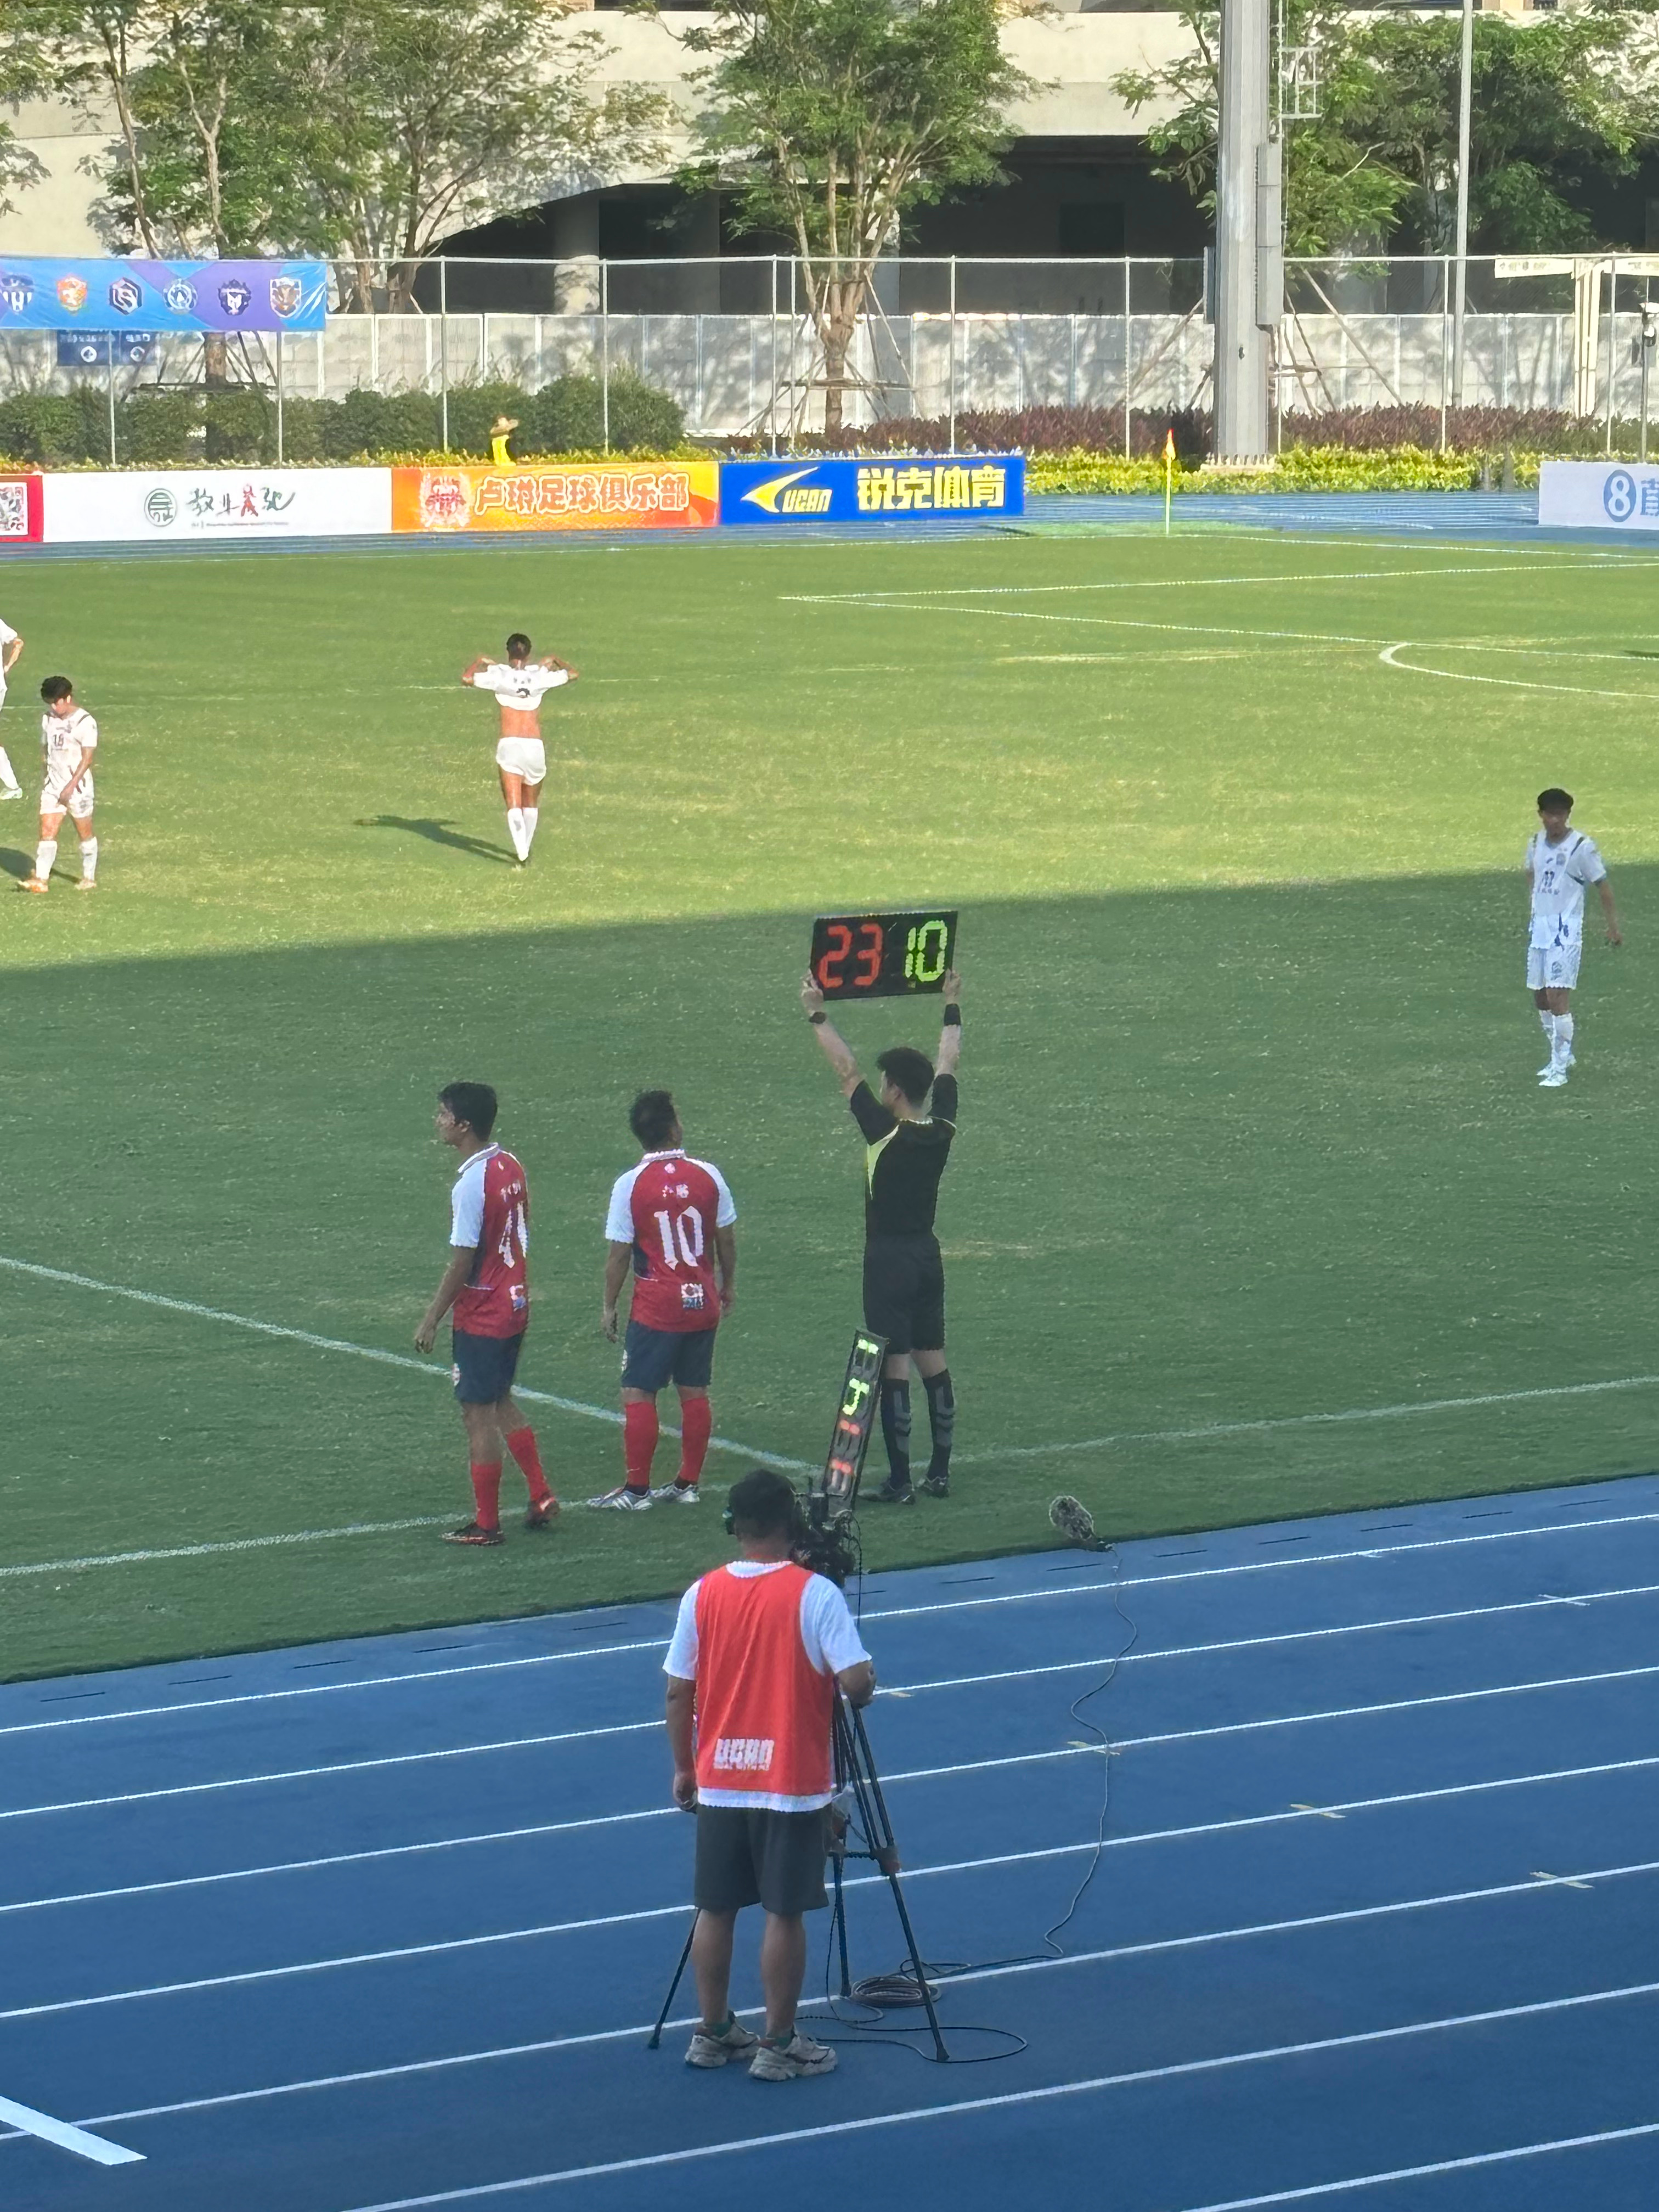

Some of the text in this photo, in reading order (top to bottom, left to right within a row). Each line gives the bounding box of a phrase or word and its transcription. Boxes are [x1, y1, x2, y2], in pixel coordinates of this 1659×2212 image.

[857, 465, 1006, 510] 锐克体育
[818, 920, 948, 988] 23 10
[653, 1205, 704, 1271] 10
